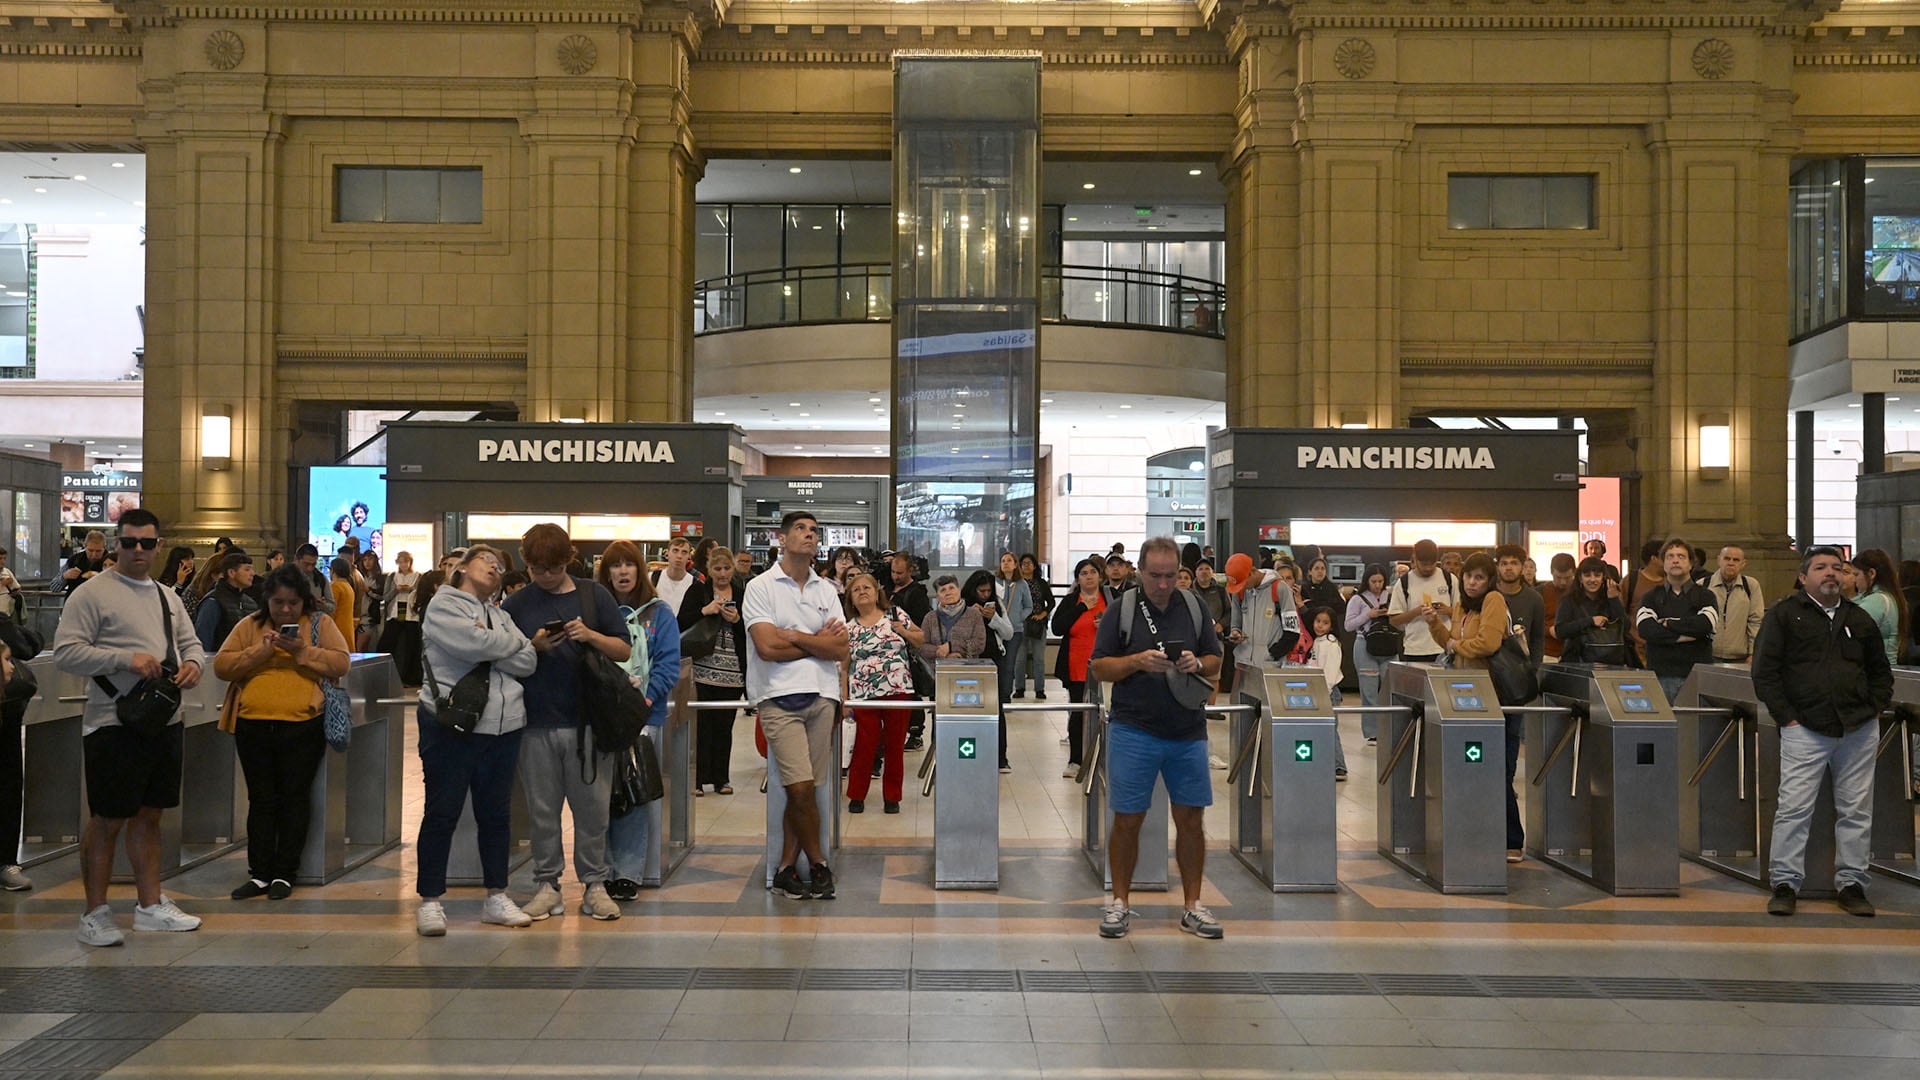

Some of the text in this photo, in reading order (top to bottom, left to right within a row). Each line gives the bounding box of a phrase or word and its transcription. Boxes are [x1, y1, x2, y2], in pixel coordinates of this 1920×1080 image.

[478, 439, 675, 463] PANCHISIMA
[1297, 446, 1496, 470] PANCHISIMA
[63, 475, 138, 487] Panadería
[1602, 517, 1615, 526] hay
[1580, 531, 1606, 543] DiDi
[1139, 601, 1157, 634] HEAD
